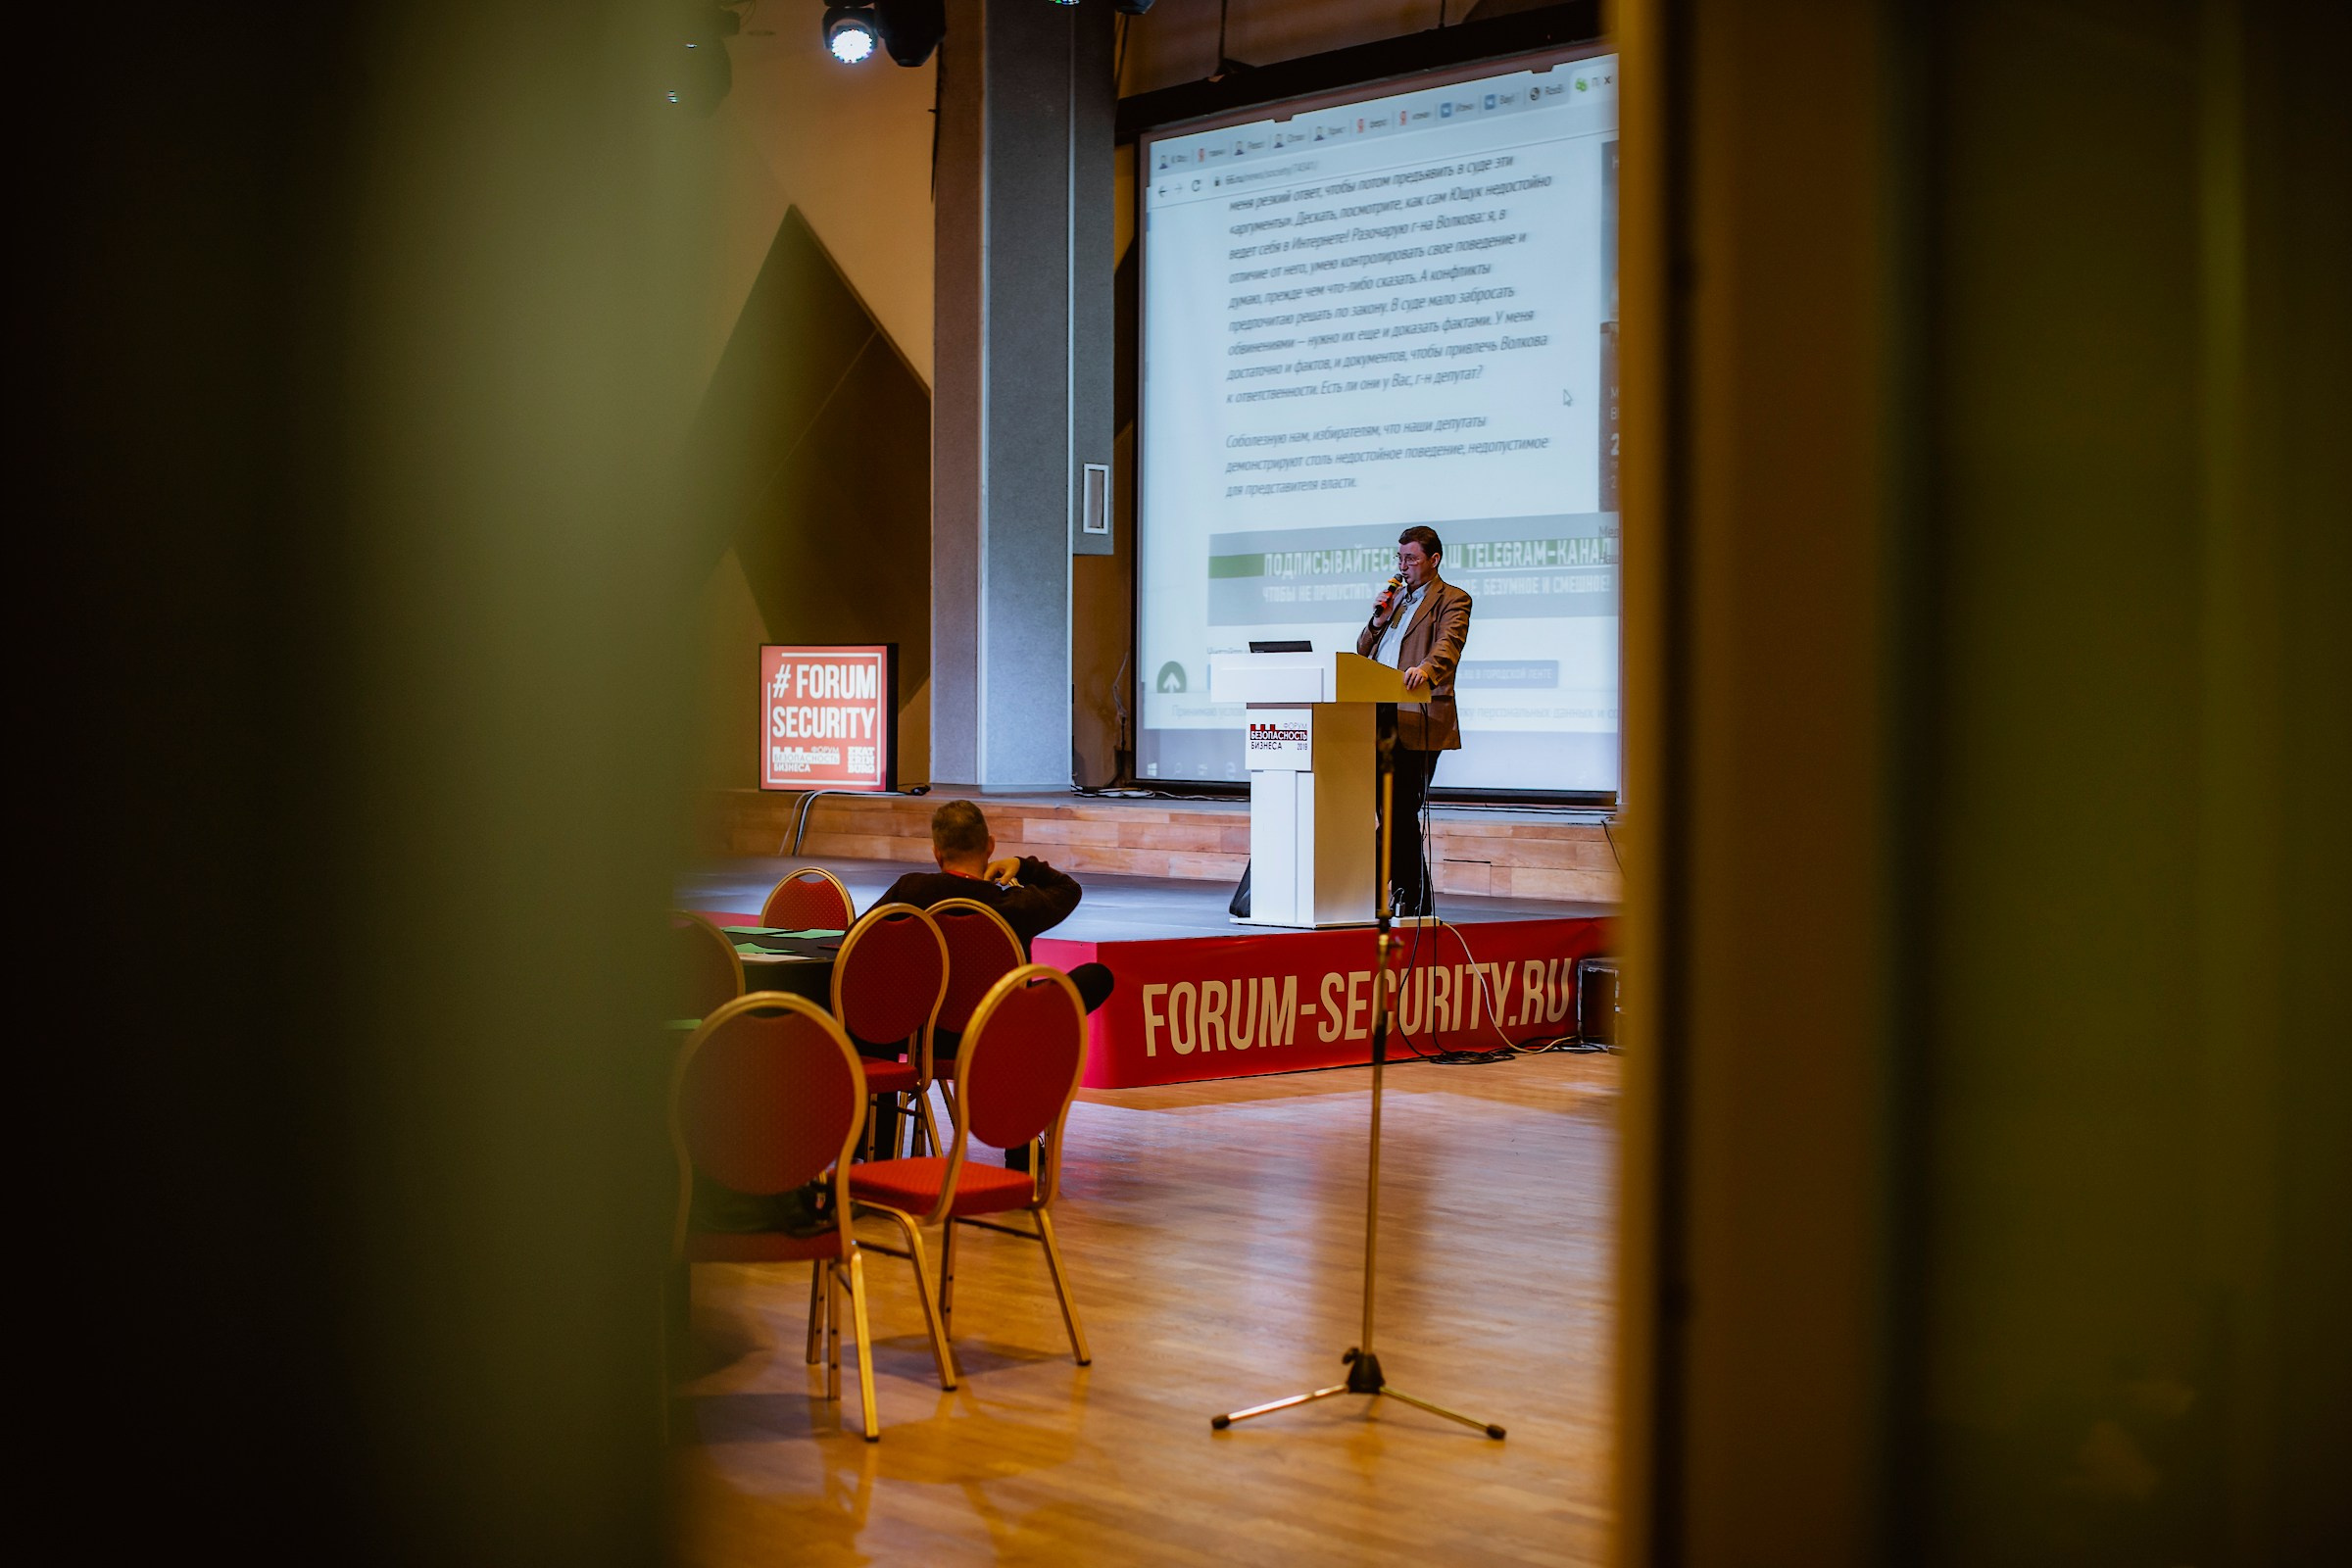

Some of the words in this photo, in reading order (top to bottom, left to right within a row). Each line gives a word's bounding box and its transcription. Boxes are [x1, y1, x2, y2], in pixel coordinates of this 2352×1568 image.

[1229, 198, 1253, 211] меня
[1255, 190, 1292, 210] резкий
[1294, 187, 1322, 202] ответ,
[1325, 179, 1355, 194] чтобы
[1358, 175, 1391, 190] потом
[1393, 166, 1454, 187] предъявить
[1457, 164, 1463, 174] в
[1467, 159, 1493, 176] суде
[1494, 156, 1514, 169] эти
[1294, 210, 1338, 226] Дескать,
[1340, 198, 1402, 217] посмотрите,
[1405, 196, 1423, 209] как
[1426, 192, 1446, 206] сам
[1448, 186, 1484, 203] Ющук
[1485, 174, 1552, 197] недостойно
[1229, 246, 1257, 260] ведет
[1258, 239, 1281, 256] себя
[1283, 241, 1290, 252] в
[1292, 229, 1349, 250] Интернете!
[1351, 223, 1408, 241] Разочарую
[1410, 221, 1433, 233] г-на
[1436, 211, 1486, 230] Волкова:
[1498, 209, 1506, 220] в
[1229, 269, 1268, 283] отличие
[1270, 268, 1282, 277] от
[1284, 264, 1308, 275] него,
[1309, 259, 1338, 275] умею
[1340, 245, 1424, 268] контролировать
[1427, 242, 1452, 256] свое
[1455, 233, 1516, 251] поведение
[1518, 232, 1527, 243] и
[1228, 294, 1262, 310] думаю,
[1264, 288, 1302, 305] прежде
[1304, 285, 1324, 297] чем
[1327, 276, 1373, 293] что-либо
[1376, 273, 1417, 288] сказать.
[1421, 269, 1428, 282] А
[1430, 263, 1492, 282] конфликты
[1229, 314, 1295, 334] предпочитаю
[1296, 309, 1333, 325] решать
[1334, 307, 1348, 318] по
[1350, 301, 1389, 317] закону.
[1391, 297, 1398, 312] В
[1401, 297, 1428, 314] суде
[1428, 294, 1455, 307] мало
[1458, 286, 1515, 305] забросать
[1228, 337, 1296, 356] обвинениями
[1307, 332, 1340, 349] нужно
[1342, 330, 1355, 341] их
[1357, 327, 1380, 340] еще
[1382, 327, 1390, 338] и
[1391, 321, 1440, 339] доказать
[1442, 315, 1492, 334] фактами.
[1494, 311, 1503, 324] У
[1505, 310, 1535, 323] меня
[1226, 364, 1283, 382] достаточно
[1285, 363, 1292, 373] и
[1294, 359, 1332, 375] фактов,
[1334, 357, 1342, 368] и
[1343, 351, 1408, 370] документов,
[1410, 344, 1443, 360] чтобы
[1445, 340, 1497, 359] привлечь
[1500, 334, 1548, 351] Волкова
[1226, 394, 1233, 404] к
[1235, 384, 1318, 404] ответственности.
[1320, 380, 1343, 395] Есть
[1344, 380, 1357, 392] ли
[1359, 378, 1381, 390] они
[1382, 377, 1390, 391] у
[1392, 372, 1413, 388] Вас,
[1414, 373, 1432, 385] г-н
[1433, 364, 1484, 386] депутат?
[1225, 432, 1287, 448] Соболезную
[1289, 431, 1310, 444] нам,
[1312, 425, 1381, 442] избирателям,
[1383, 422, 1401, 434] что
[1403, 420, 1433, 433] наши
[1434, 416, 1488, 433] депутаты
[1225, 456, 1303, 473] демонстрируют
[1305, 454, 1333, 466] столь
[1335, 447, 1402, 466] недостойное
[1404, 443, 1466, 459] поведение,
[1468, 437, 1549, 455] недопустимое
[1226, 485, 1243, 498] для
[1245, 479, 1318, 498] представителя
[1320, 477, 1356, 490] власти.
[1262, 585, 1296, 603] ЧТОБЫ
[1298, 585, 1311, 602] НЕ
[1312, 582, 1373, 601] ПРОПУСТИТЬ
[796, 663, 876, 700] FORUM
[772, 706, 876, 739] SECURITY
[1250, 730, 1307, 741] БЕЗОПАСНОСТЬ
[773, 753, 839, 763] БЕЗОПАСНОСТЬ
[1250, 742, 1283, 751] БИЗНЕСА
[1142, 957, 1572, 1058] FORUM-SECURITY.RU
